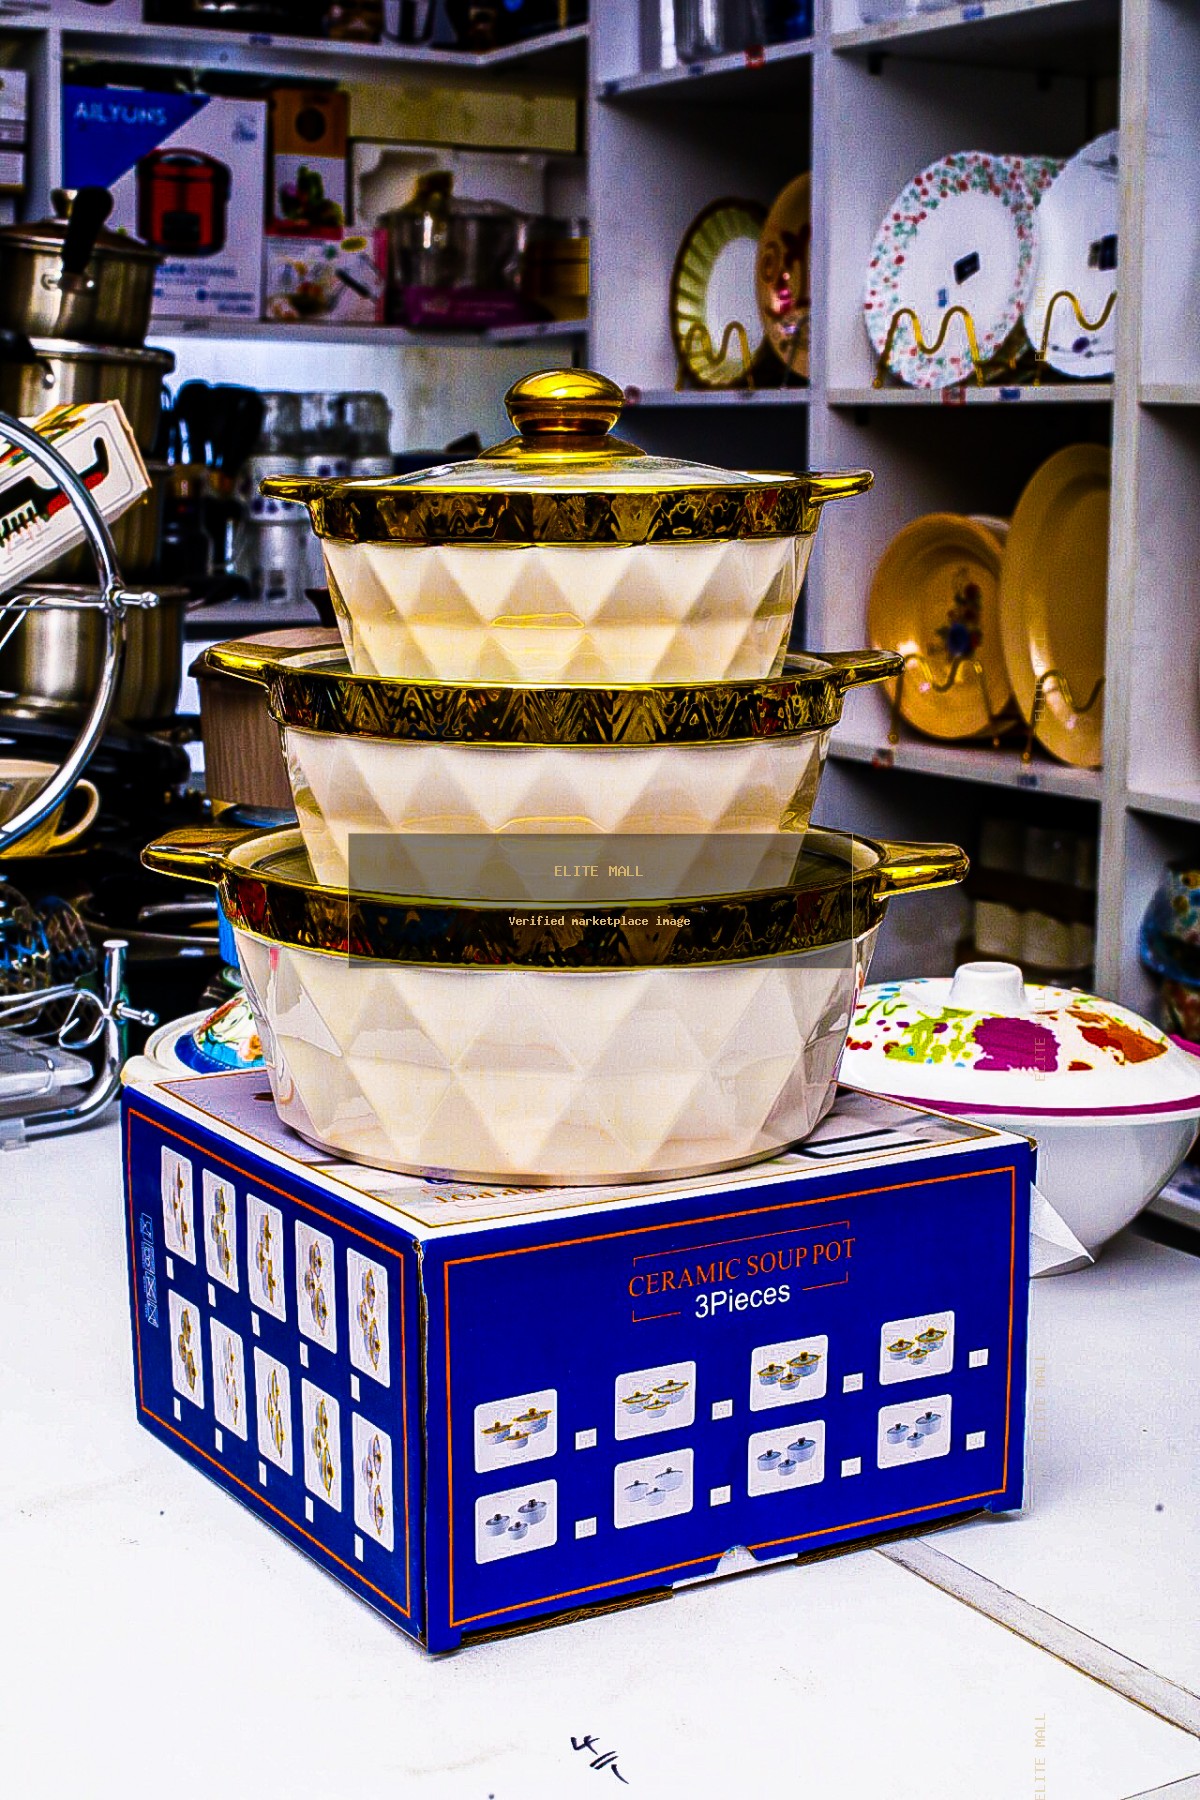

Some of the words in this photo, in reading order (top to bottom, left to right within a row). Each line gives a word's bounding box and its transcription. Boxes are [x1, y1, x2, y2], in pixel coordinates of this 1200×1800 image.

[628, 1258, 742, 1297] CERAMIC
[746, 1247, 808, 1276] SOUP
[812, 1238, 856, 1265] POT
[695, 1284, 791, 1318] 3Pieces
